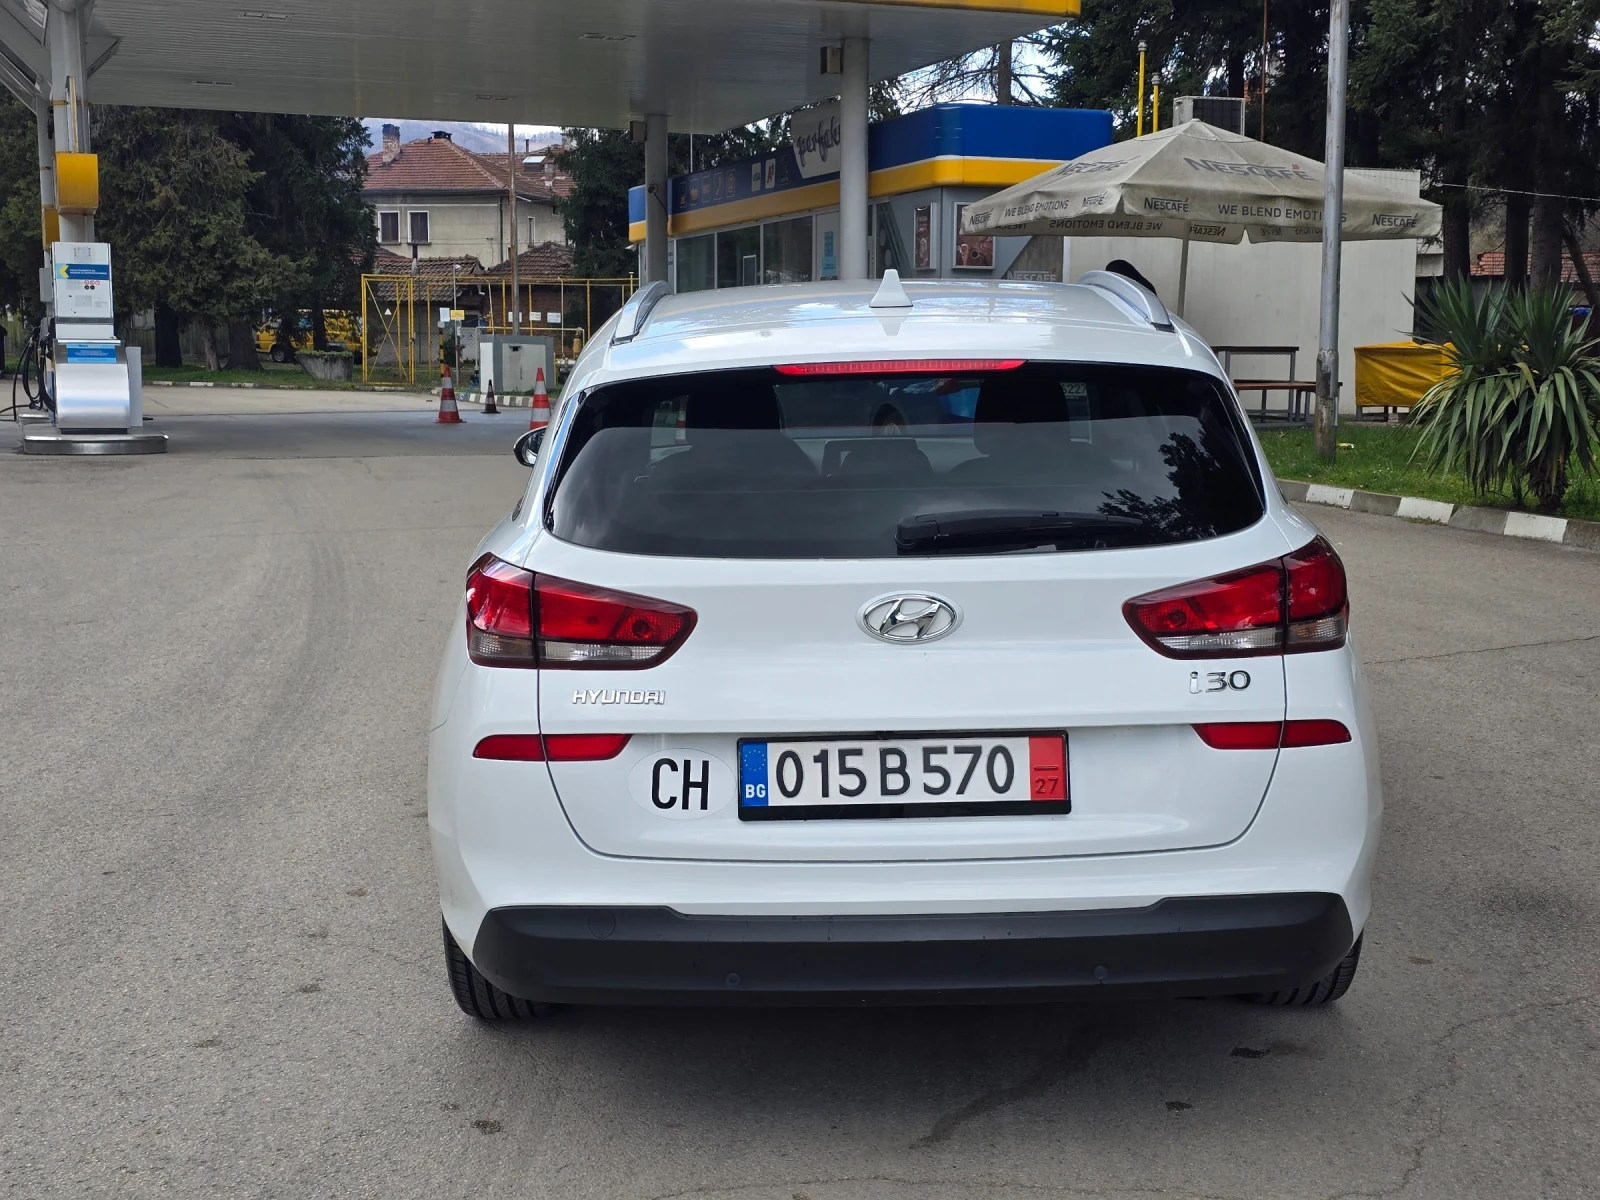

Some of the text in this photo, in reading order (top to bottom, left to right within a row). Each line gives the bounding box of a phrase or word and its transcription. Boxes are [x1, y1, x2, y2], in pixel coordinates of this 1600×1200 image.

[1183, 157, 1314, 180] NESCAFÉ
[1005, 208, 1017, 217] WE
[1035, 200, 1069, 211] EMOTIONS
[1144, 197, 1190, 212] NESCAFÉ
[1218, 204, 1238, 215] WE
[1242, 206, 1281, 218] BLEND
[1372, 213, 1418, 228] NESCAFÉ
[572, 690, 665, 705] HYUNDAI
[652, 758, 709, 810] CH
[745, 784, 766, 799] BG
[1035, 776, 1059, 794] 27
